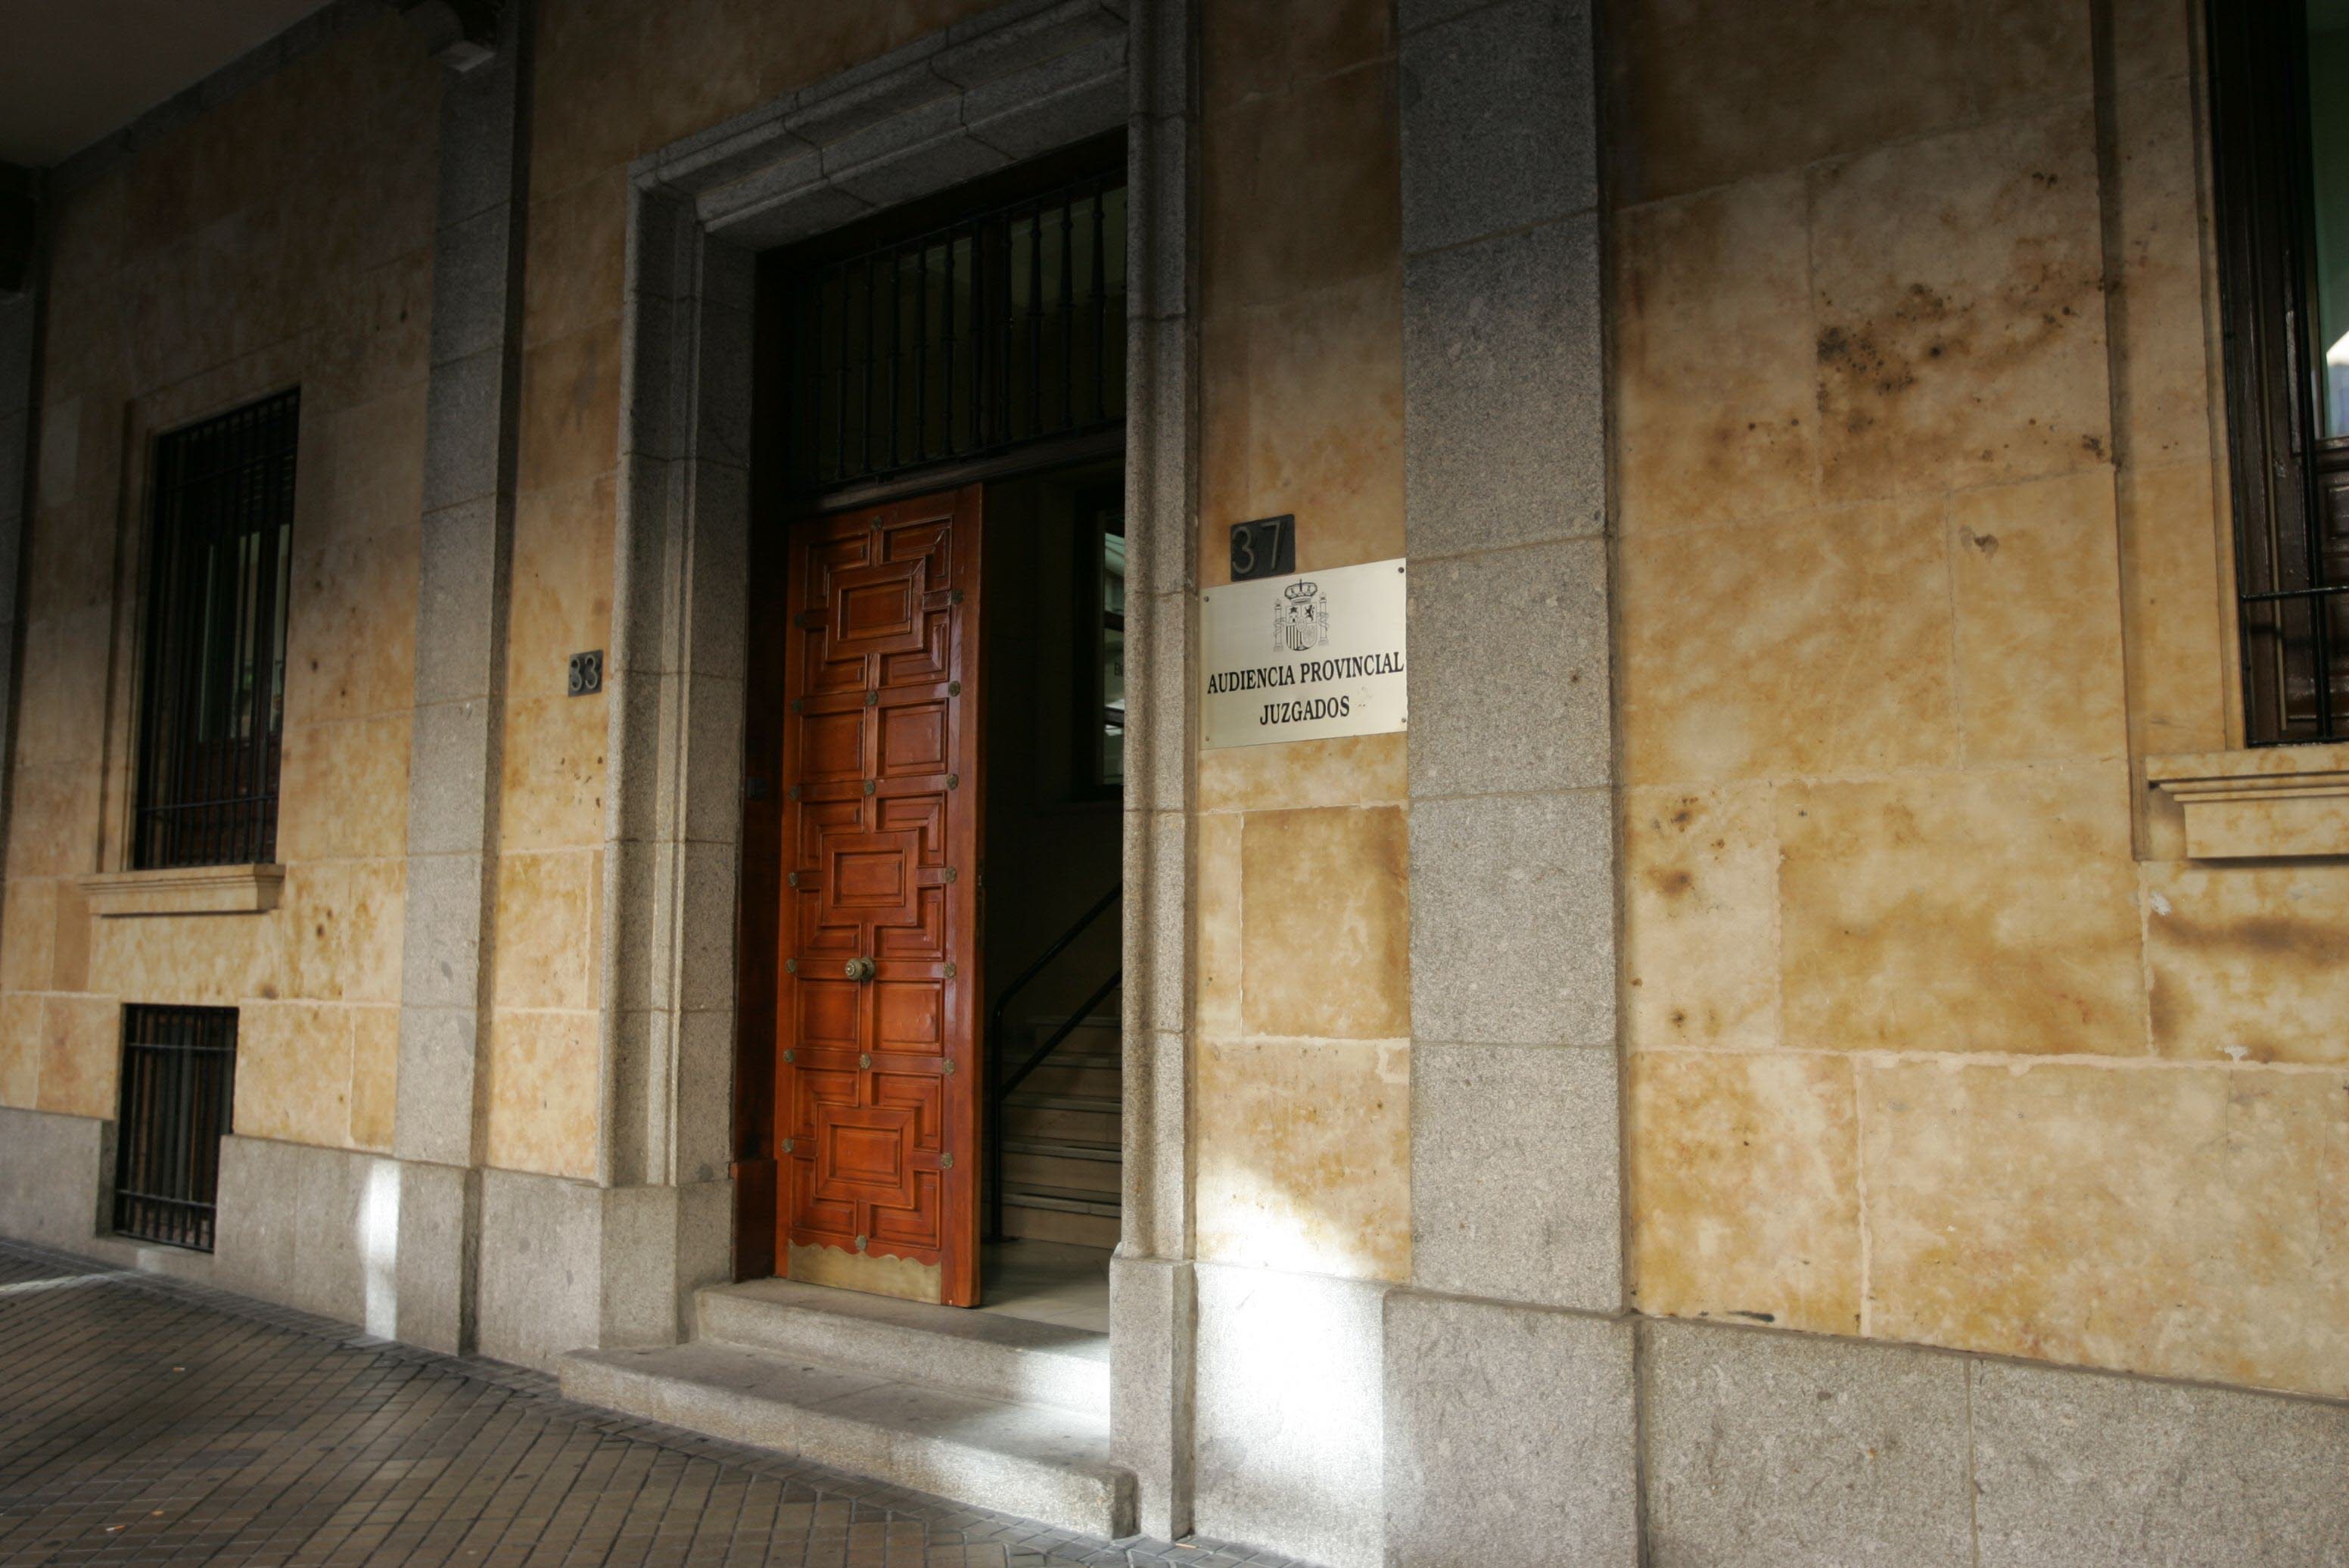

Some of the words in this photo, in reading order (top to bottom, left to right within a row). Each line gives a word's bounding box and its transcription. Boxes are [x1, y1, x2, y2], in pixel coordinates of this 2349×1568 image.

[1231, 520, 1280, 574] 37
[570, 654, 598, 691] 33
[1207, 665, 1296, 694] AUDIENCIA
[1300, 652, 1405, 683] PROVINCIAL
[1260, 695, 1350, 725] JUZGADOS
